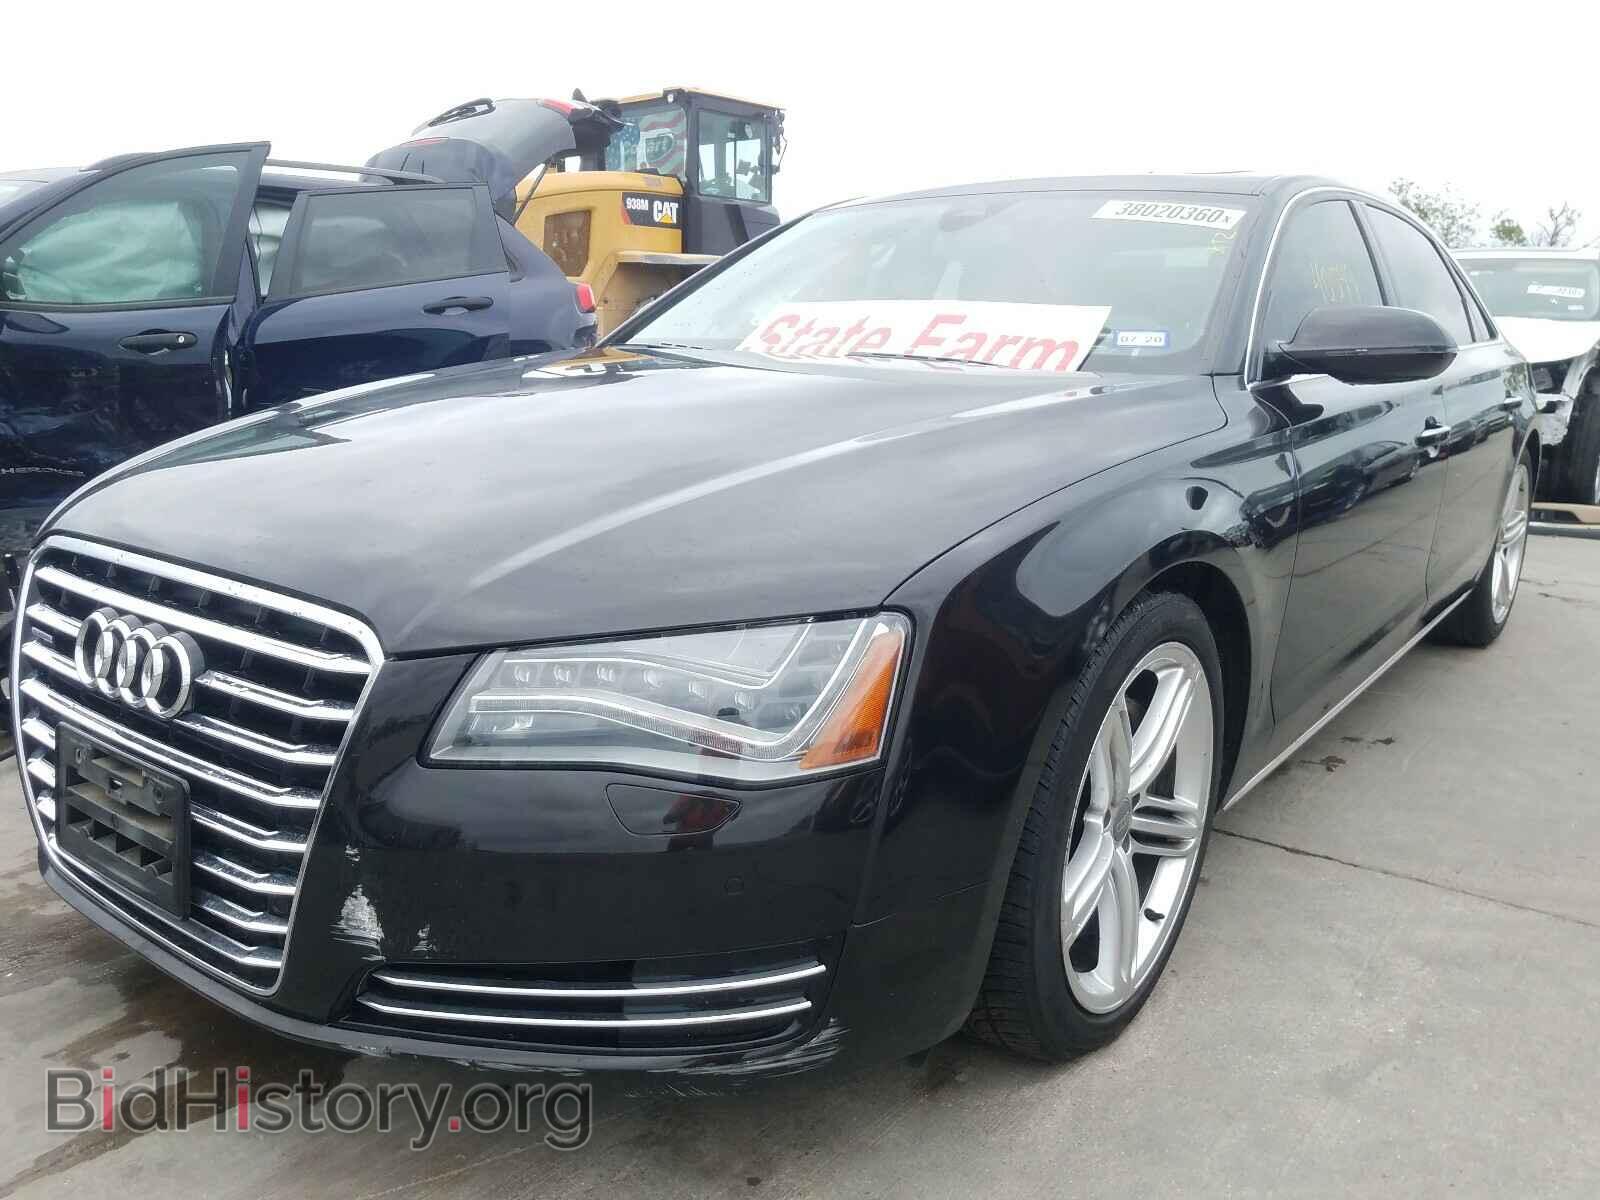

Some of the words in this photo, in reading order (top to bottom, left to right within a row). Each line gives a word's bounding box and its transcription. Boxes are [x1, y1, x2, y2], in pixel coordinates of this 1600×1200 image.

[626, 197, 649, 211] 938M
[653, 200, 679, 225] CAT
[758, 314, 893, 361] State
[904, 313, 1080, 373] Farm
